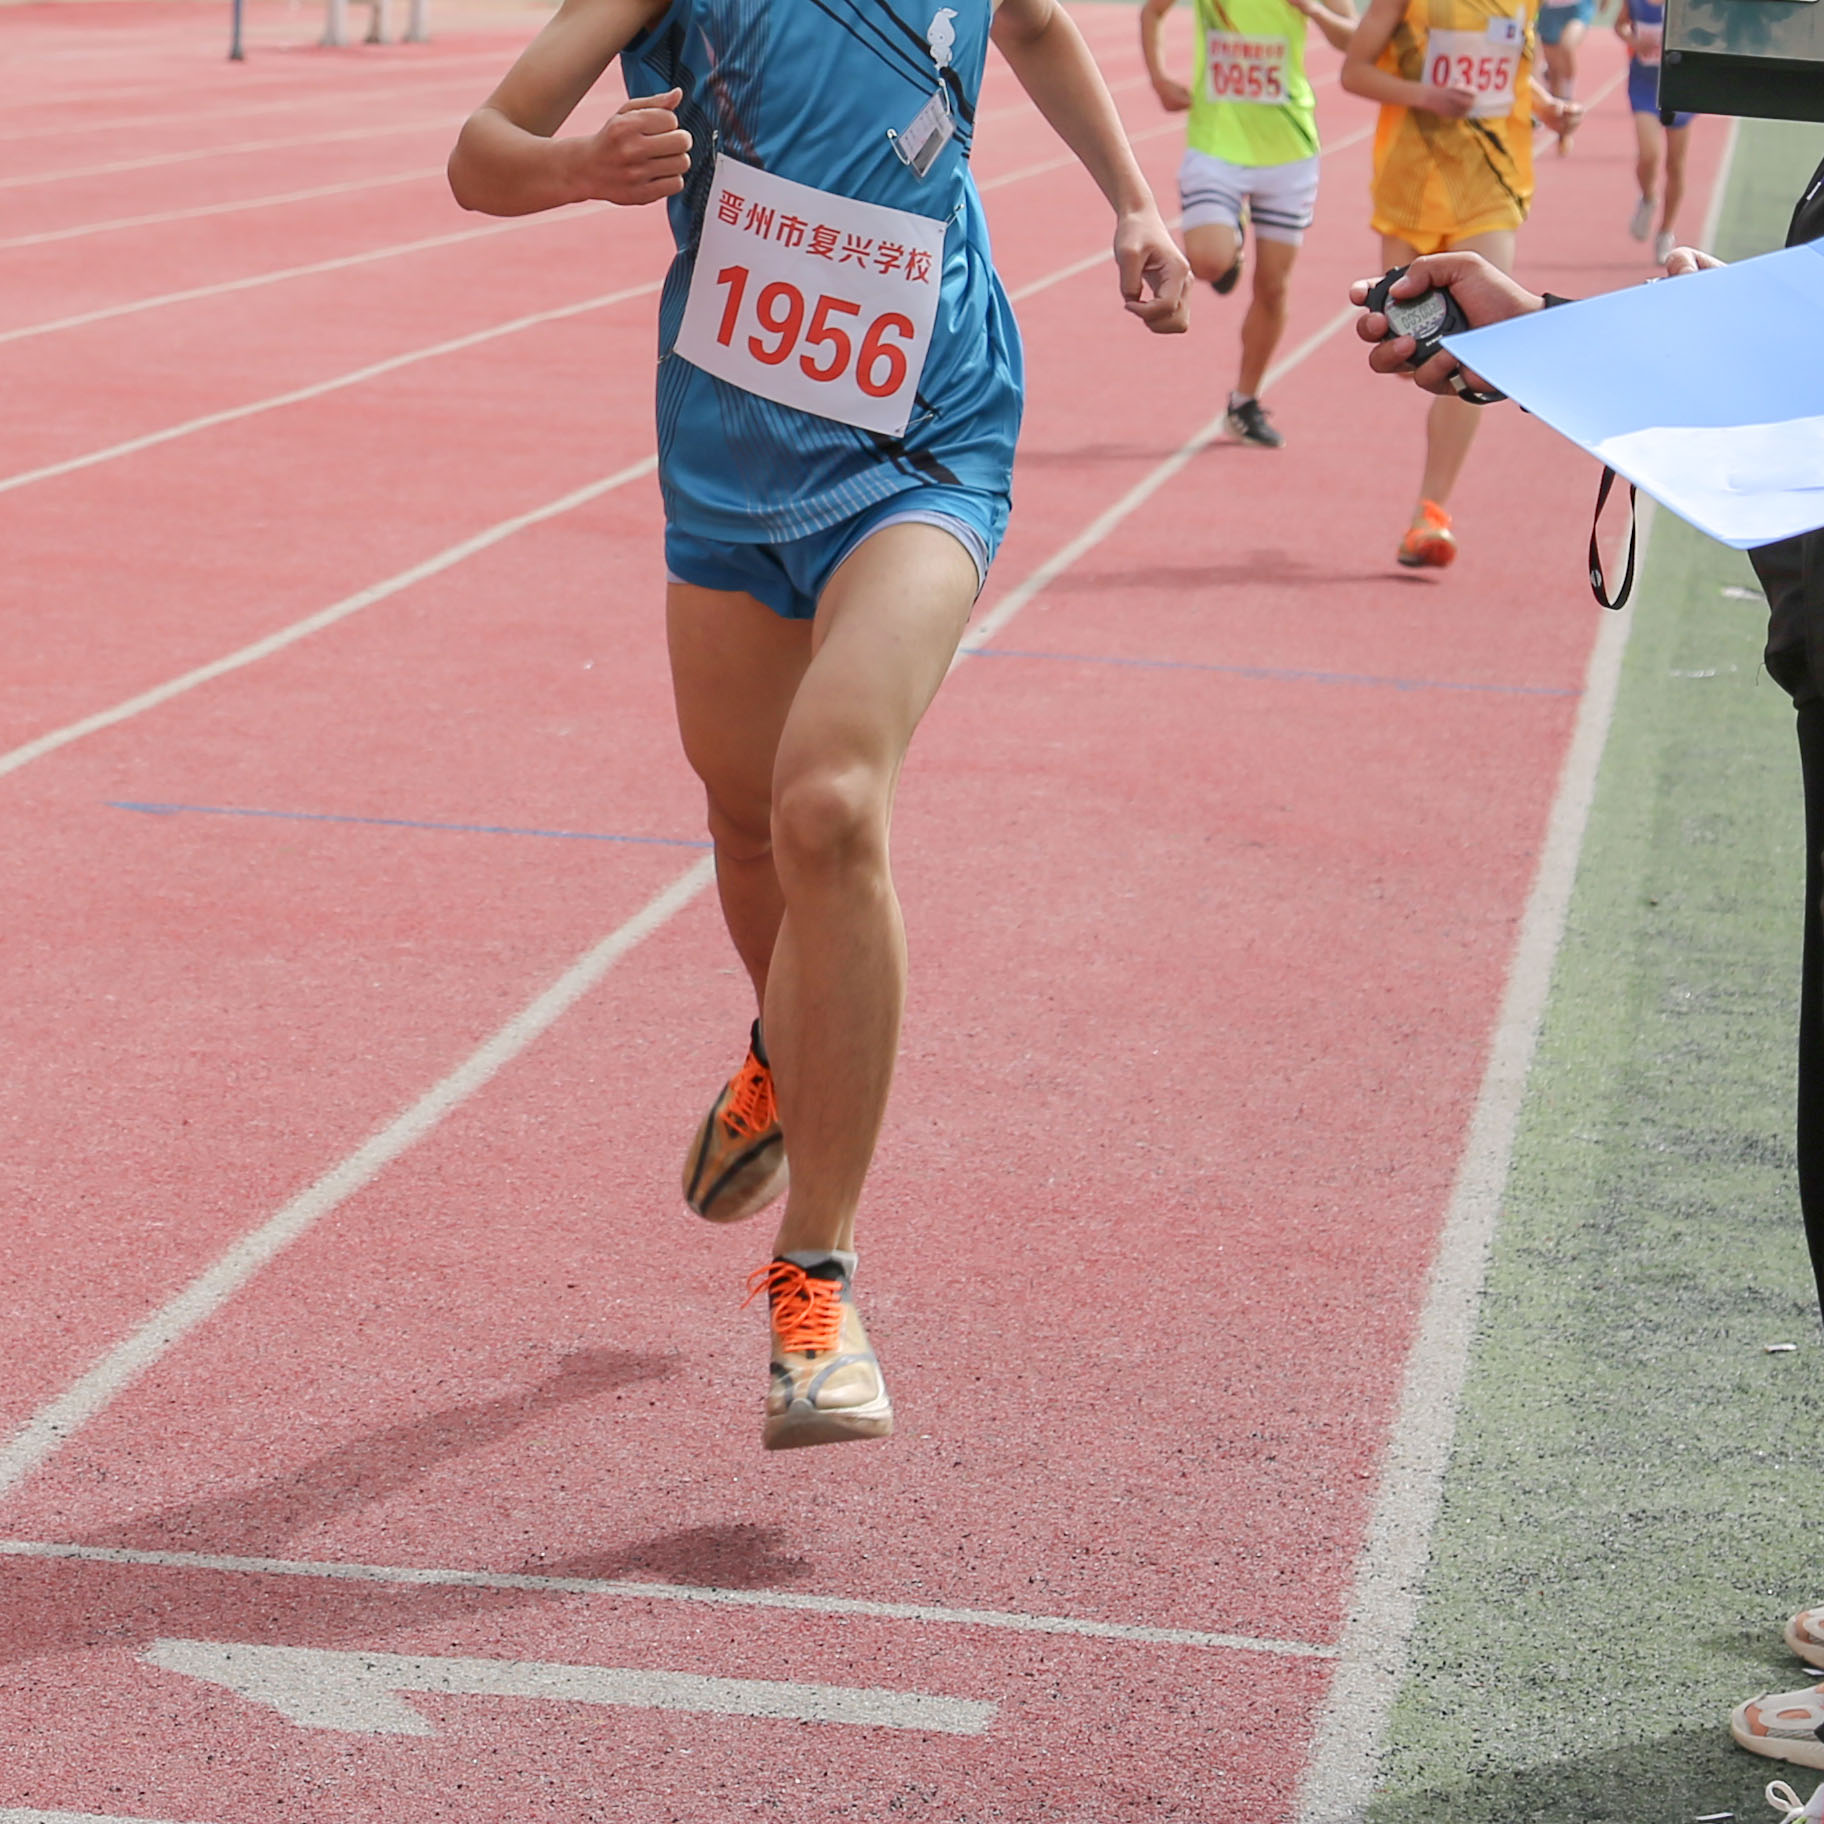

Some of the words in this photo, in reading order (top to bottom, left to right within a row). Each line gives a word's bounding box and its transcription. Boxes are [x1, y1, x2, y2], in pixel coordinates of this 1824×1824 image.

[1431, 53, 1512, 92] 0355
[717, 188, 934, 285] 晋州市复兴学校
[714, 264, 916, 399] 1956
